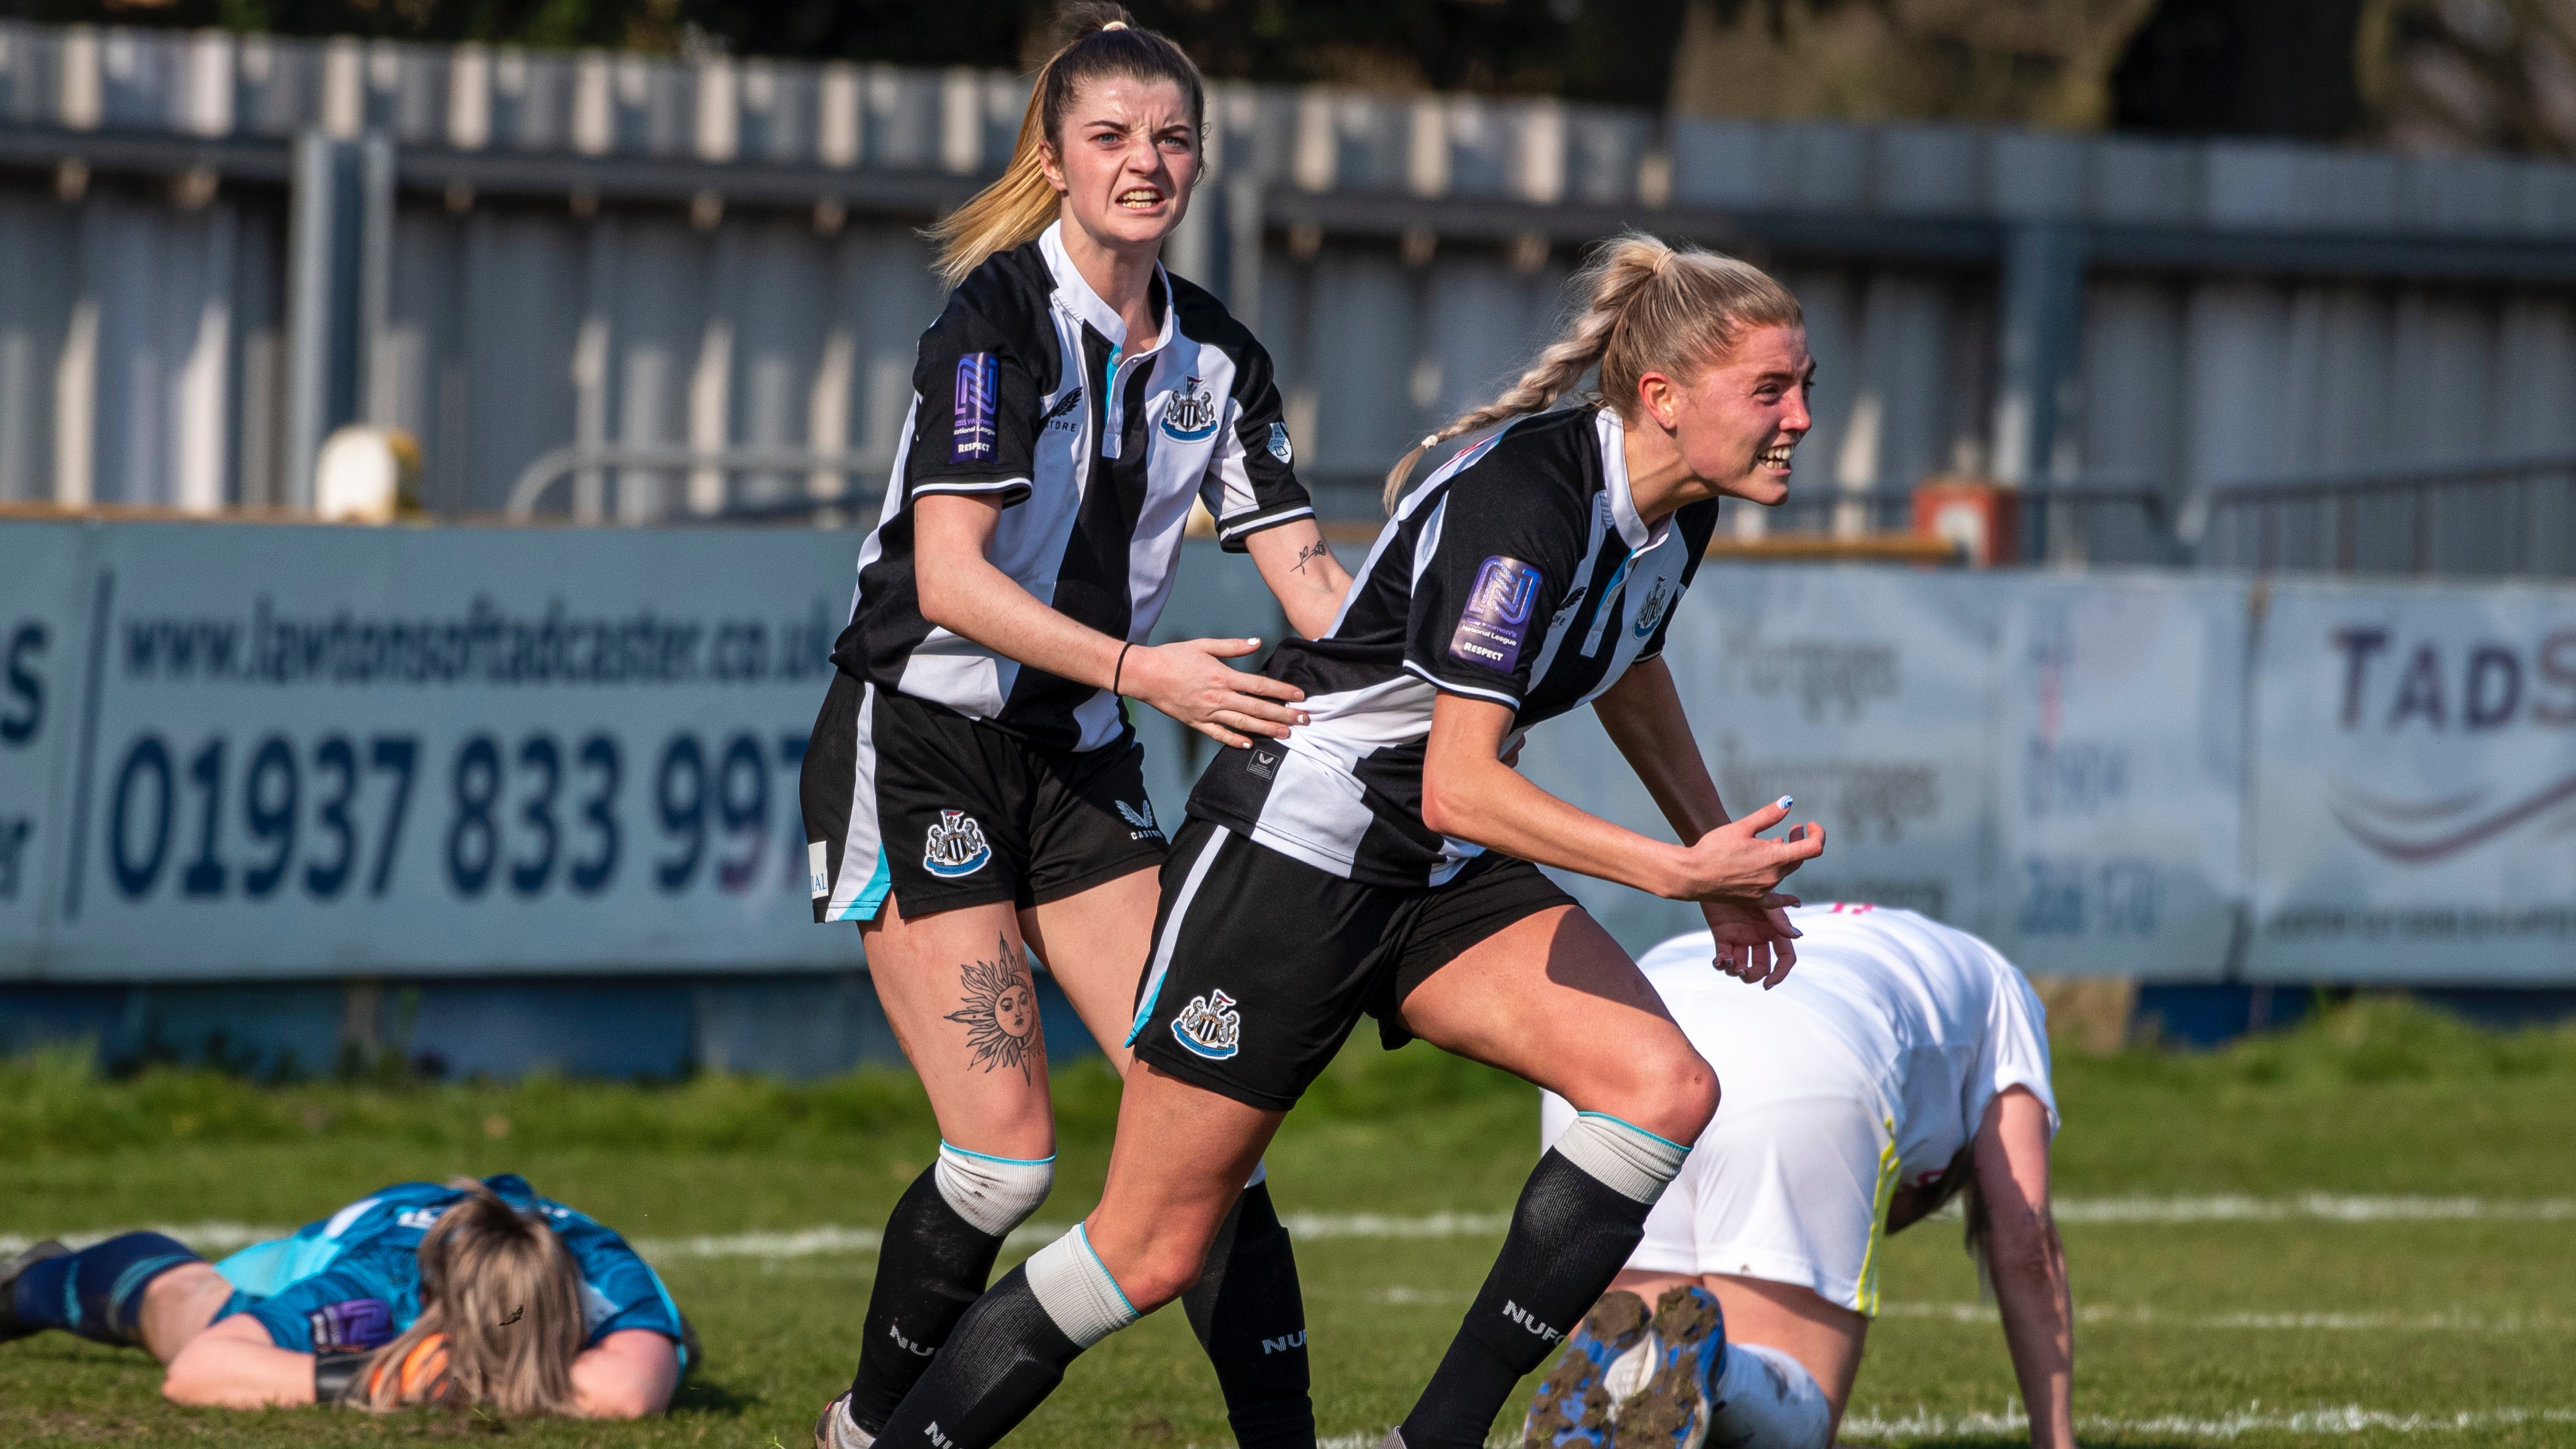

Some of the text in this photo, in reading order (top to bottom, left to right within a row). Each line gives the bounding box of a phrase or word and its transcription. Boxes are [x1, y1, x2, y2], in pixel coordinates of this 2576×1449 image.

[1047, 420, 1077, 432] TORE
[958, 442, 990, 453] RESPECT
[1461, 624, 1517, 646] National League
[1464, 642, 1503, 661] RESPECT
[110, 734, 418, 903] 01937
[445, 734, 625, 902] 833
[1181, 1033, 1205, 1052] NEWCASTLE
